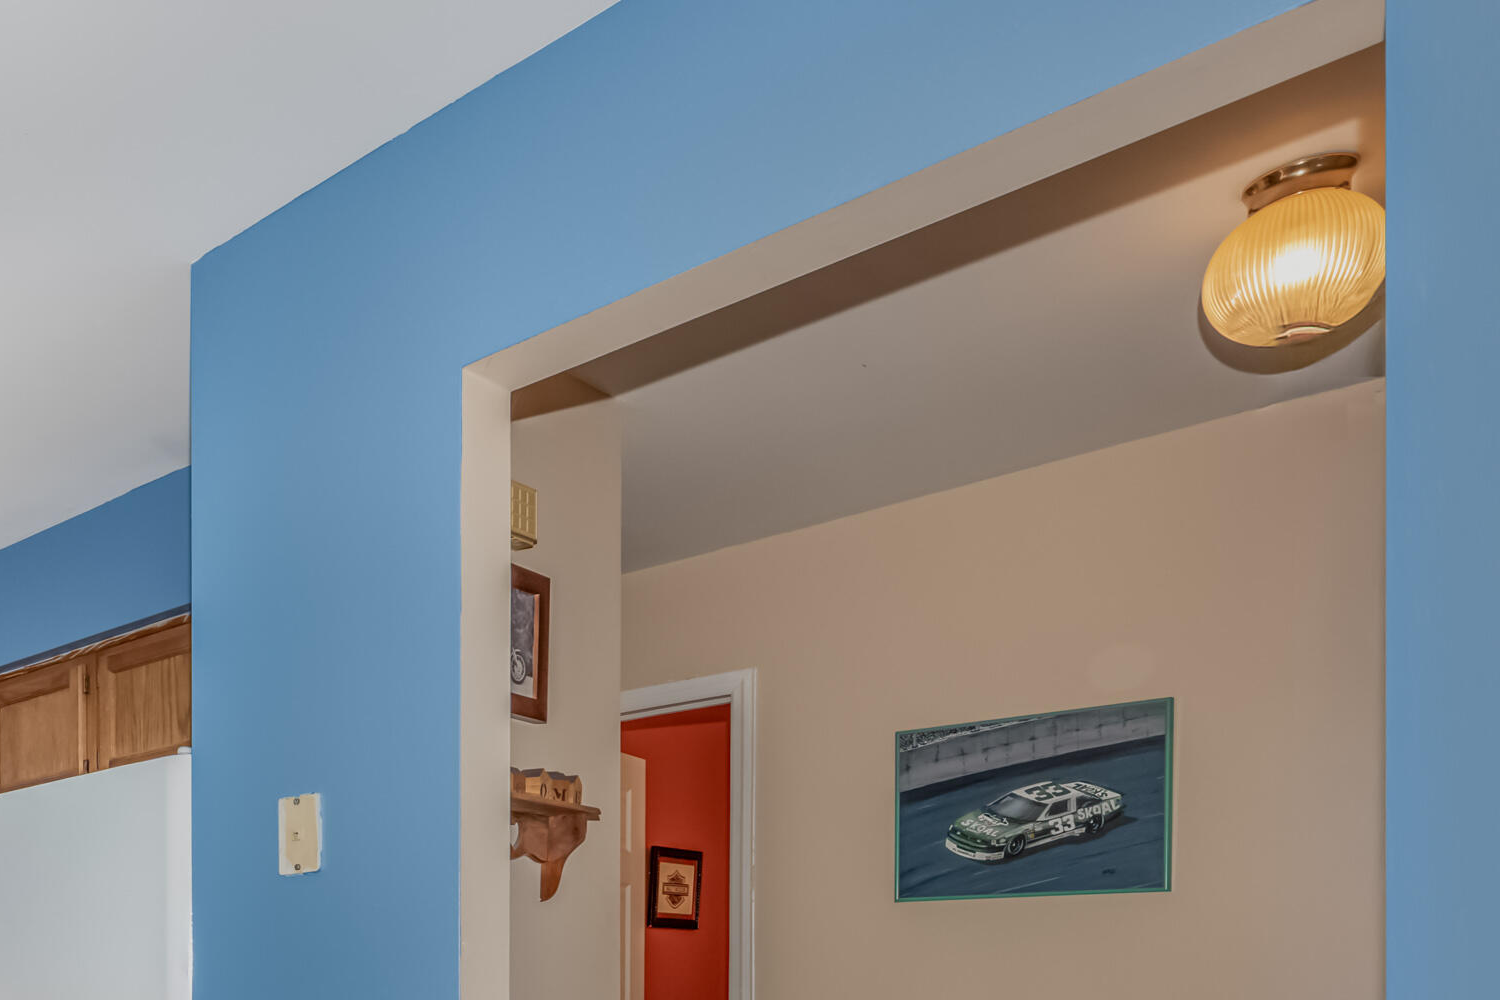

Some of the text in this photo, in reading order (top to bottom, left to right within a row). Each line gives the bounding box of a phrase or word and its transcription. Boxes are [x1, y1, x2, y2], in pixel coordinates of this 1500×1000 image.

[1025, 783, 1071, 801] 33
[1077, 799, 1121, 820] SKOAL
[961, 820, 999, 837] SKOAL
[1049, 814, 1076, 835] 33
